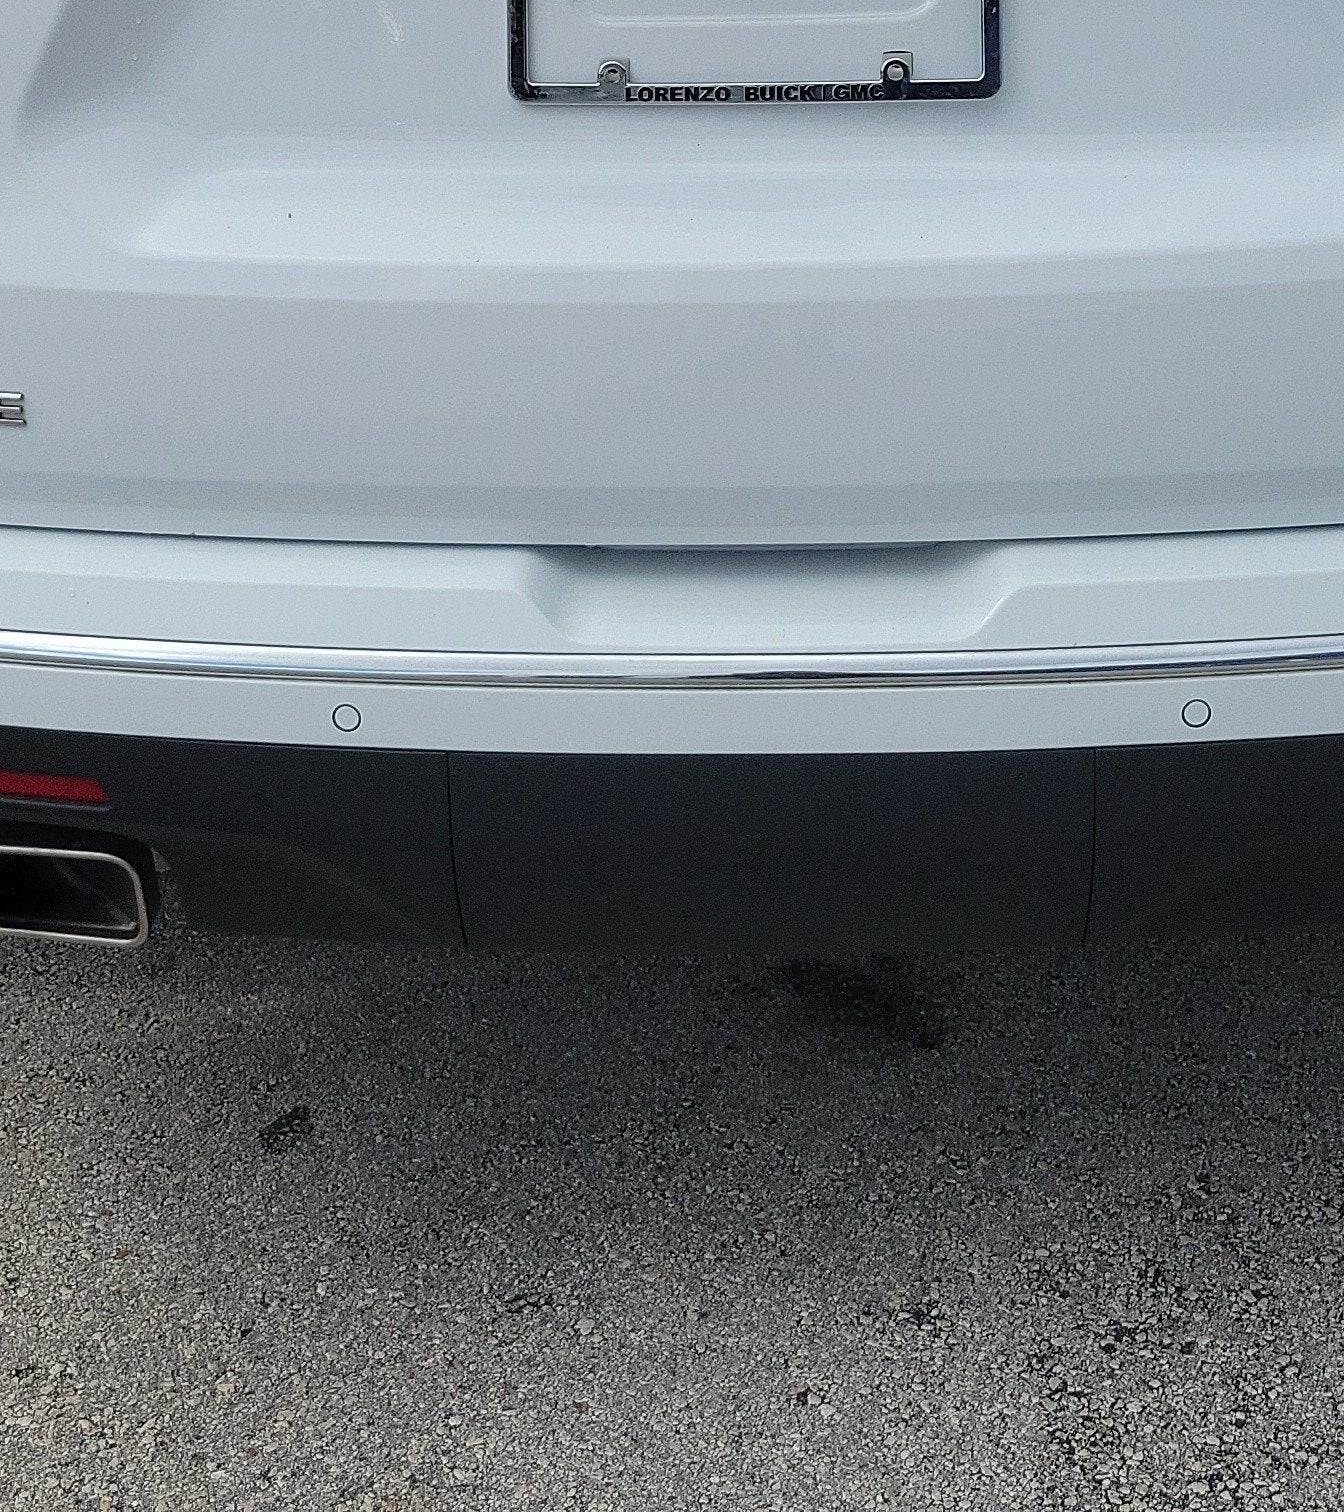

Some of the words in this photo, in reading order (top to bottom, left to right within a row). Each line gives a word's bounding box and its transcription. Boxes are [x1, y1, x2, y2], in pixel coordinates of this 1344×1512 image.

[624, 86, 731, 103] LORENZO
[744, 85, 815, 102] BUICK
[832, 83, 886, 101] GMC
